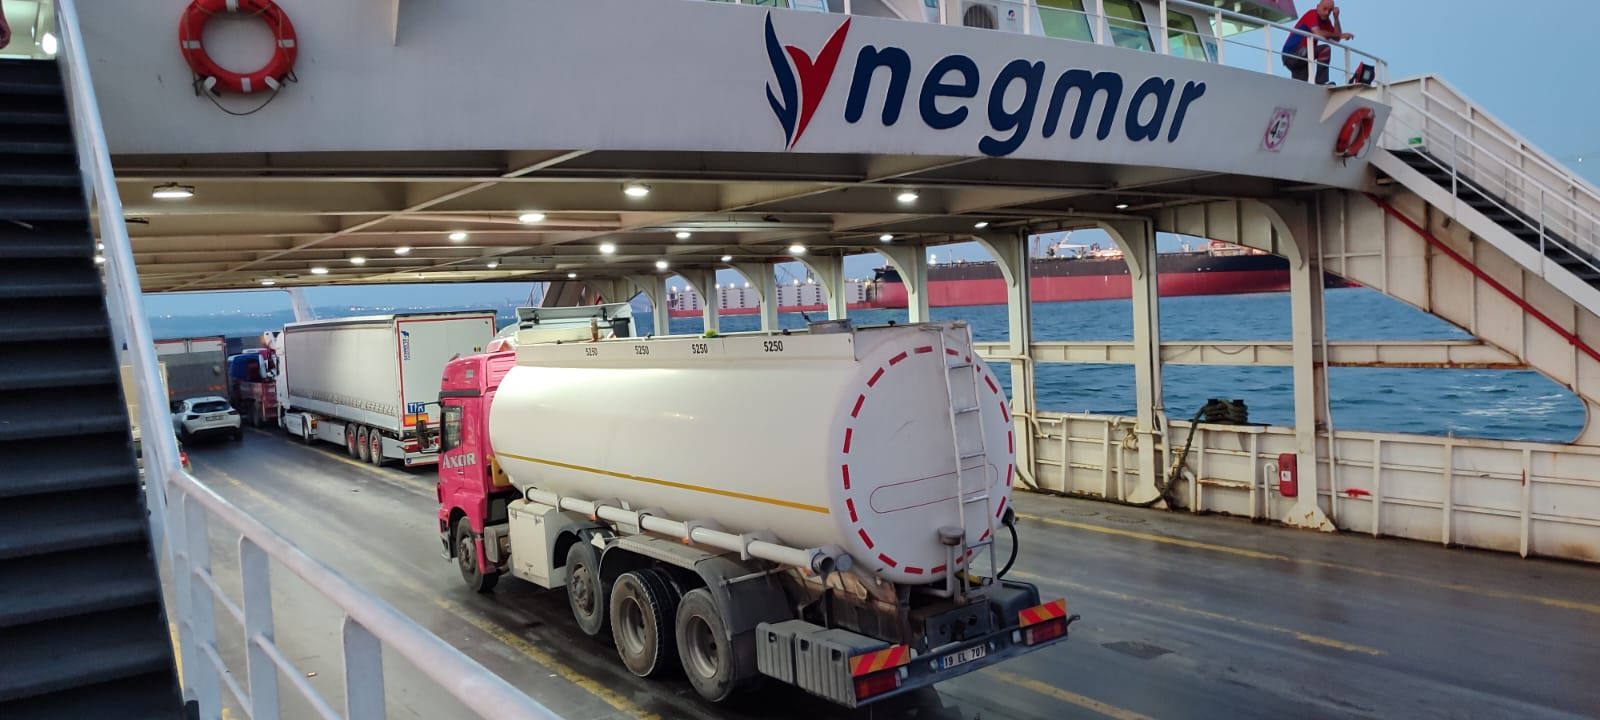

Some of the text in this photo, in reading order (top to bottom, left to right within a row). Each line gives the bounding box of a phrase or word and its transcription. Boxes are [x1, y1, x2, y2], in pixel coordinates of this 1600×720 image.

[845, 44, 1206, 157] negmar
[634, 345, 650, 355] 5250
[691, 343, 708, 354] 5250
[763, 340, 784, 352] 5250
[945, 646, 984, 667] 19 EL 707
